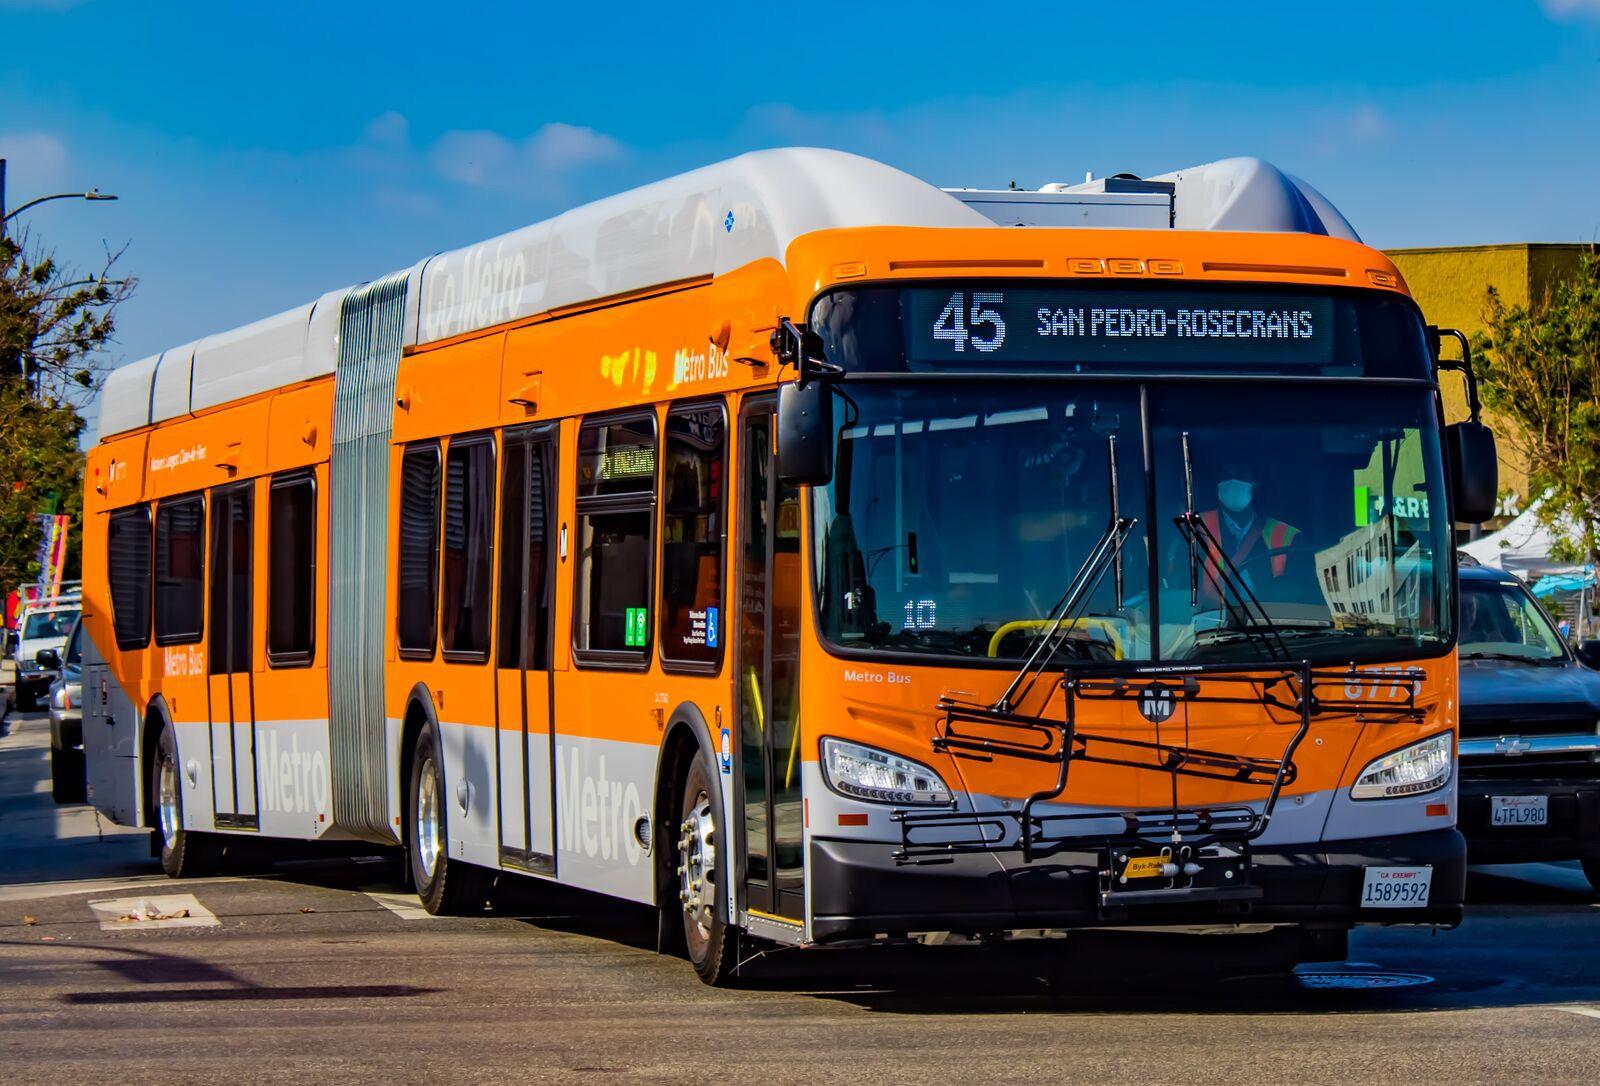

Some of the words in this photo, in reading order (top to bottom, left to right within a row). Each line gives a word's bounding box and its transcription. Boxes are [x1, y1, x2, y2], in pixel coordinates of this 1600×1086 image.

[426, 256, 456, 342] Go
[457, 241, 526, 333] Metro
[934, 292, 1006, 352] 45
[1037, 308, 1085, 336] SAN
[1091, 308, 1313, 338] PEDRO-ROSECRANS
[674, 348, 705, 385] Metro
[707, 343, 730, 379] Bus
[904, 600, 936, 629] 10
[164, 646, 187, 677] Metro
[189, 644, 204, 677] Bus
[844, 670, 883, 683] Metro
[887, 672, 911, 684] Bus
[259, 730, 328, 814] Metro
[557, 744, 641, 866] Metro
[1494, 807, 1545, 823] 4TFL980
[1365, 882, 1427, 902] 1589592
